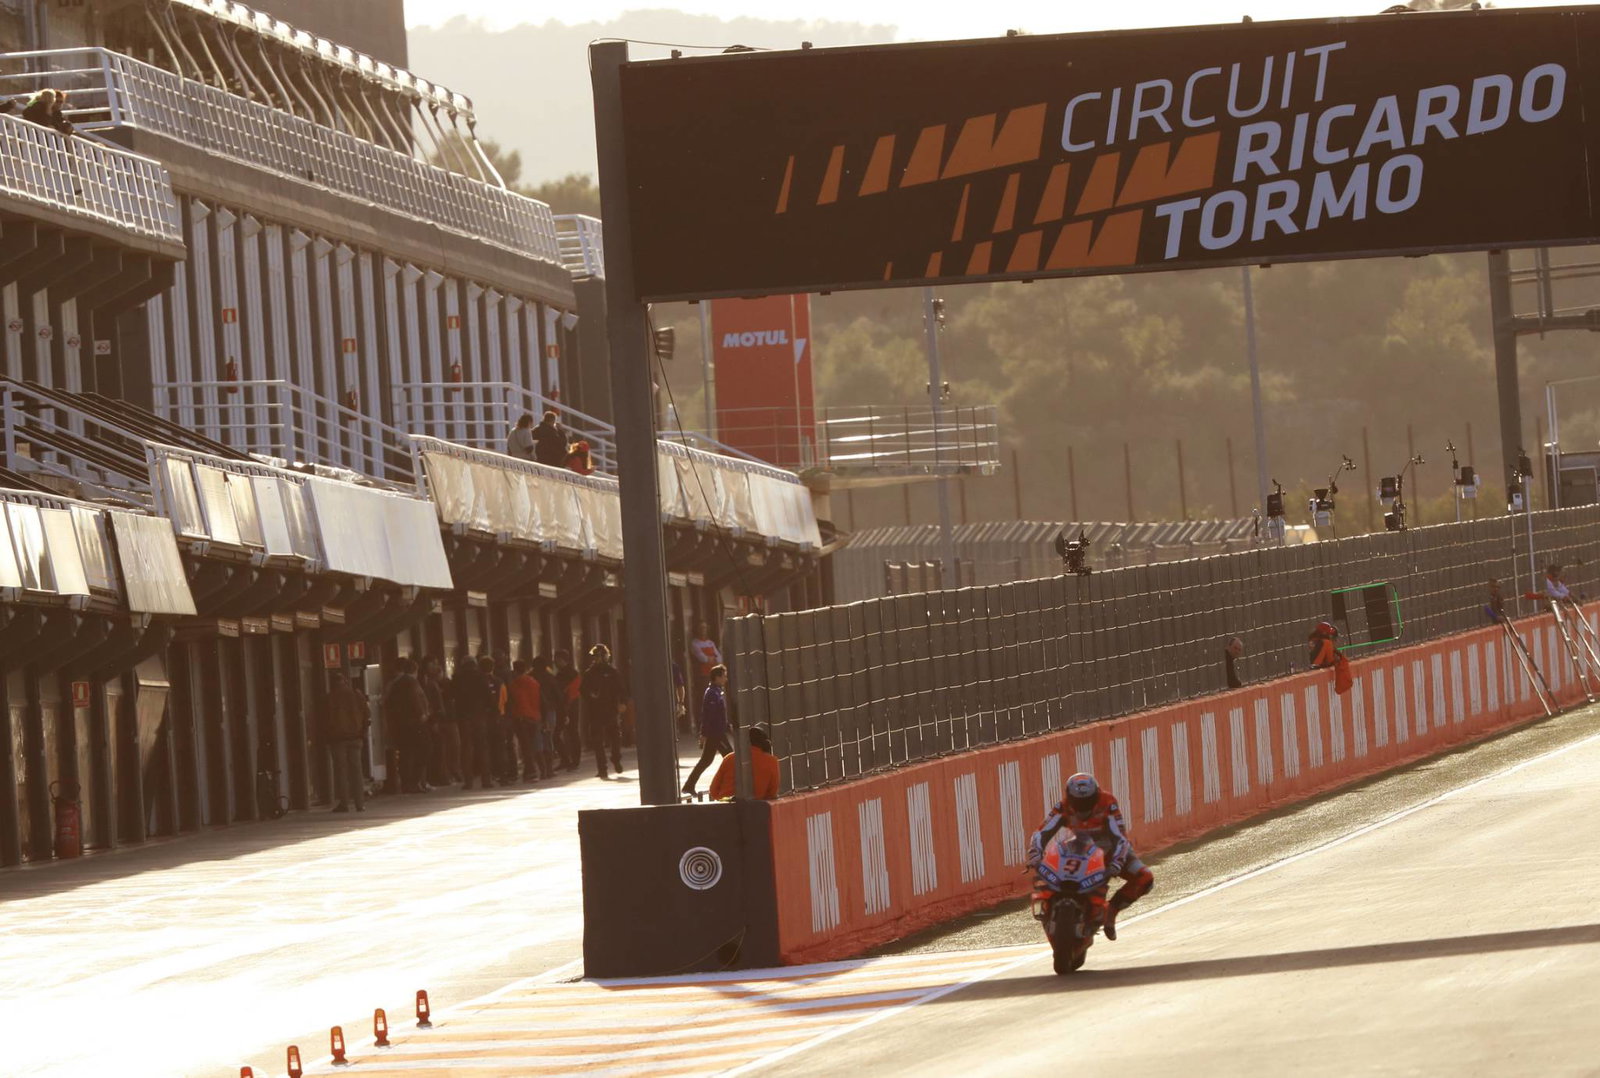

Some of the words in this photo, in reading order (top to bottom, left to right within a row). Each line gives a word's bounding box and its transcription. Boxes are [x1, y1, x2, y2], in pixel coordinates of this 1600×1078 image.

[1061, 42, 1347, 153] CIRCUIT
[1233, 63, 1567, 183] RICARDO
[1155, 154, 1424, 260] TORMO
[722, 329, 789, 348] MOTUL
[1064, 859, 1081, 874] 9
